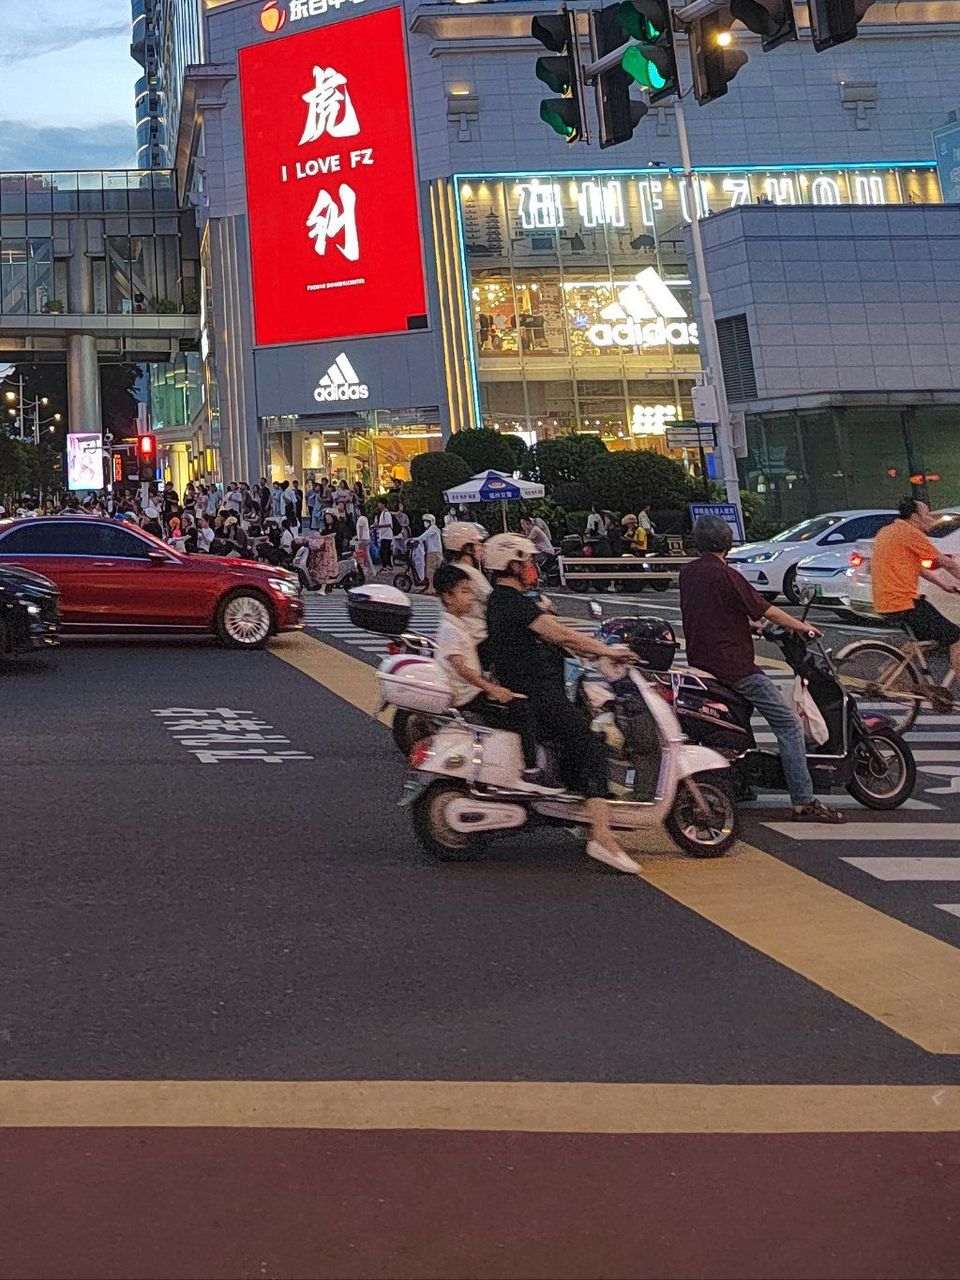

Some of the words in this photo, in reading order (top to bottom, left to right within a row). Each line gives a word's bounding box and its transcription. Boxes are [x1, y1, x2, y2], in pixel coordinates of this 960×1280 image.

[298, 65, 361, 146] 虎
[281, 165, 288, 182] I
[296, 154, 341, 180] LOVE
[350, 148, 374, 169] FZ
[519, 178, 635, 229] 福州
[314, 383, 369, 402] adidas
